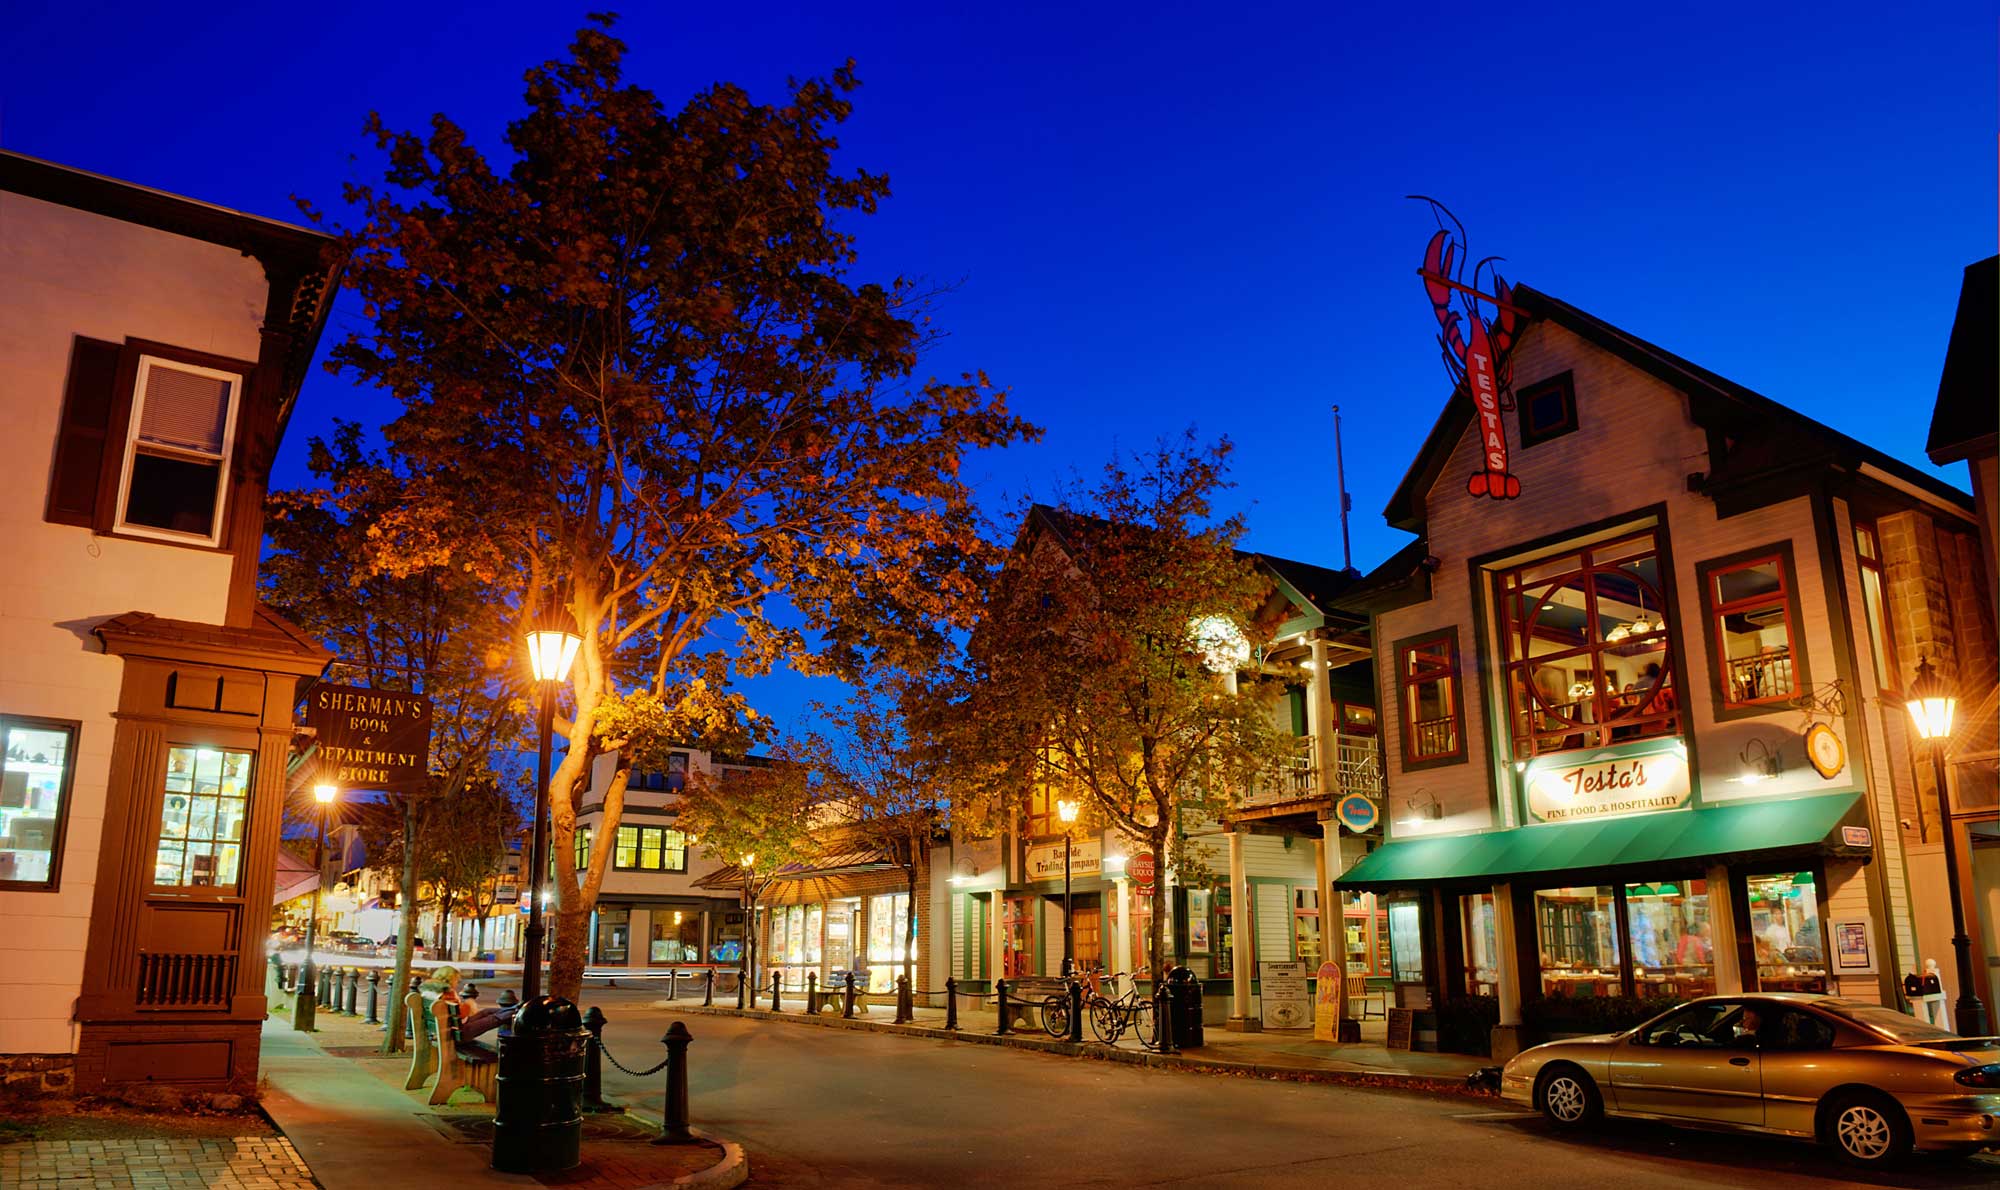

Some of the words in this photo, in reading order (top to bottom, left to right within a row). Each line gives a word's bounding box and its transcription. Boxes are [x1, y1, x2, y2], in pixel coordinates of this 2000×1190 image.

[1474, 352, 1506, 470] TESTA'S
[319, 691, 422, 719] SHERMAN'S
[350, 717, 389, 733] BOOK
[363, 736, 371, 745] &
[338, 766, 389, 783] STORE
[1563, 760, 1648, 795] Testa's
[1547, 808, 1566, 819] FINE
[1570, 805, 1596, 817] FOOD
[1600, 804, 1610, 812] &
[1611, 795, 1678, 812] HOSPITALITY
[1053, 846, 1081, 862] Bayide
[1036, 861, 1064, 874] Trading
[1067, 857, 1099, 871] ompany
